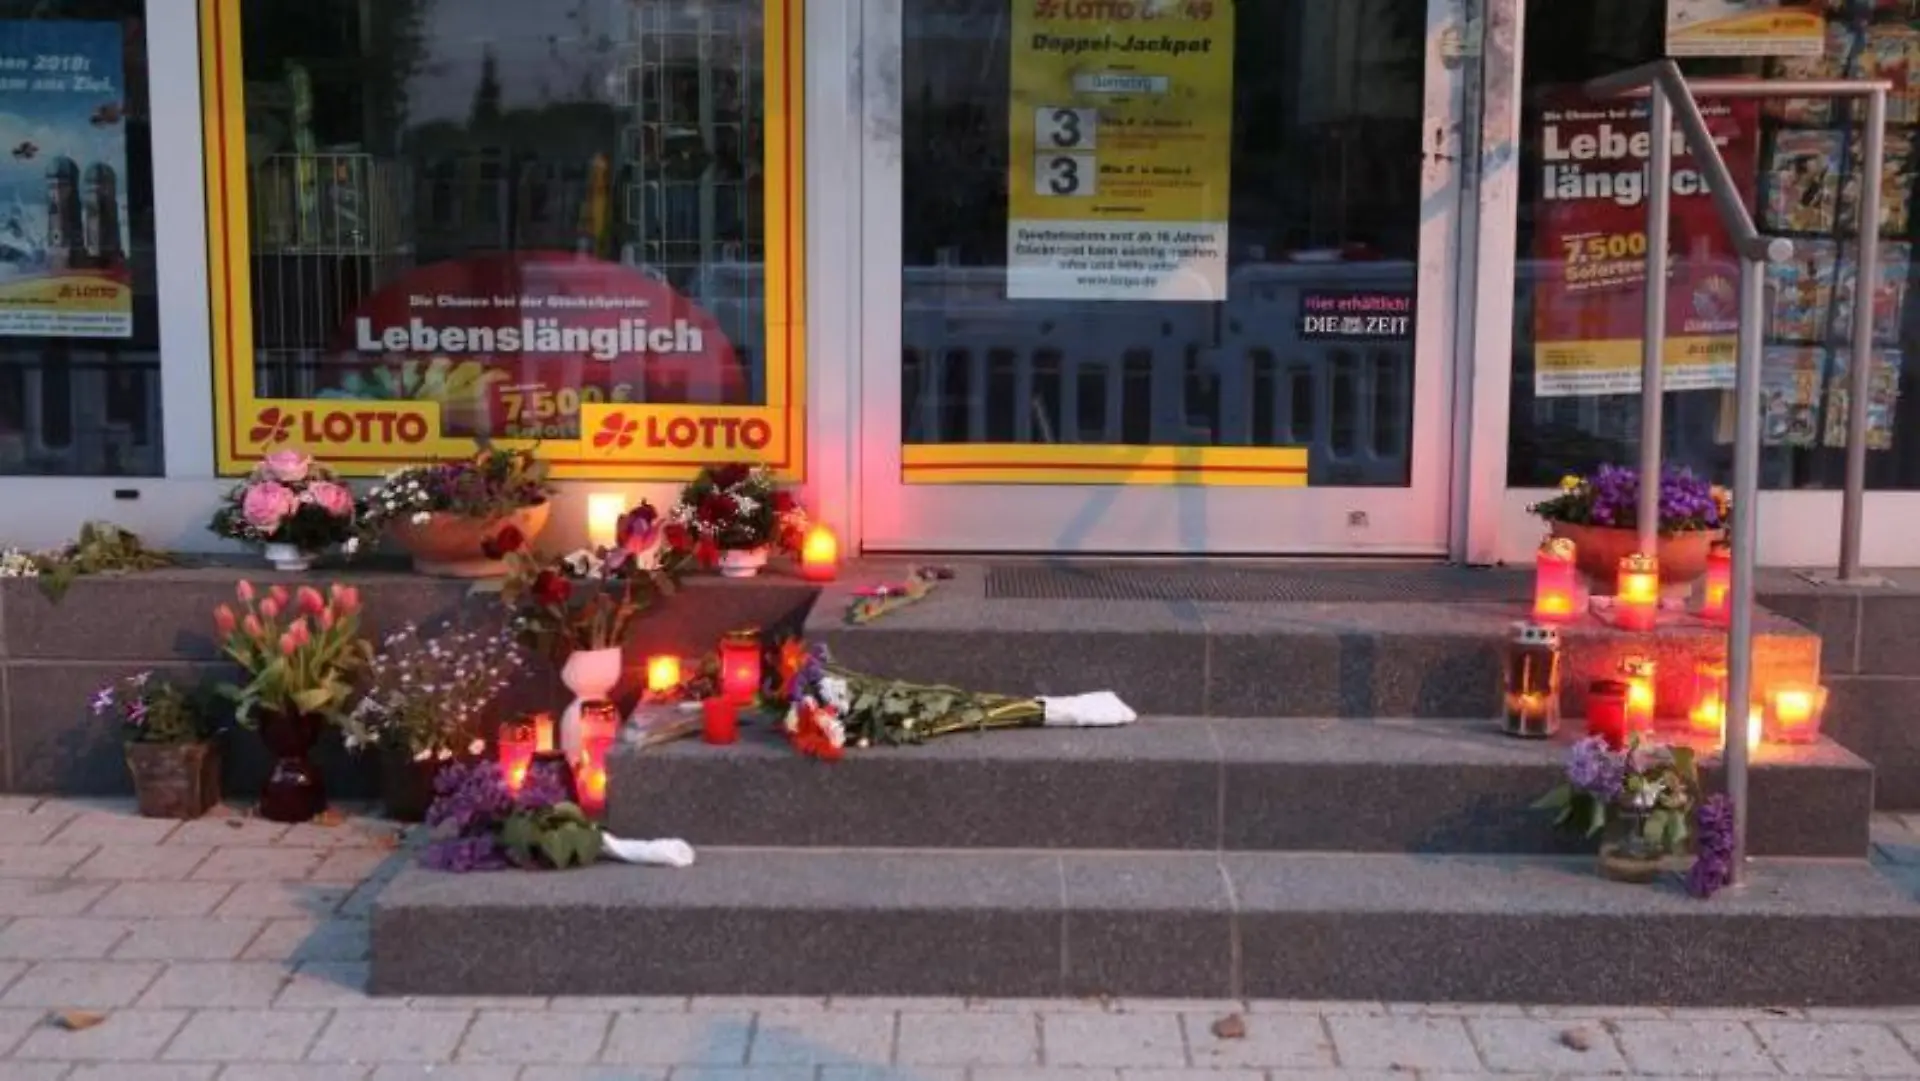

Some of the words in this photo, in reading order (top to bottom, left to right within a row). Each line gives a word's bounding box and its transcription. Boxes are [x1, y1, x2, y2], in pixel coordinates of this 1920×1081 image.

[1031, 33, 1213, 56] Doppel-Jackpot
[1052, 109, 1081, 148] 3
[1050, 156, 1080, 195] 3
[1563, 232, 1647, 265] 7.500
[409, 294, 434, 307] Die
[437, 294, 490, 307] Chance
[493, 294, 516, 307] bei
[519, 294, 543, 307] der
[1304, 295, 1335, 309] Hier
[355, 317, 703, 361] Lebenslänglich
[1304, 316, 1339, 333] DIE
[1367, 316, 1409, 335] ZEIT
[302, 411, 429, 443] LOTTO
[646, 416, 772, 449] LOTTO
